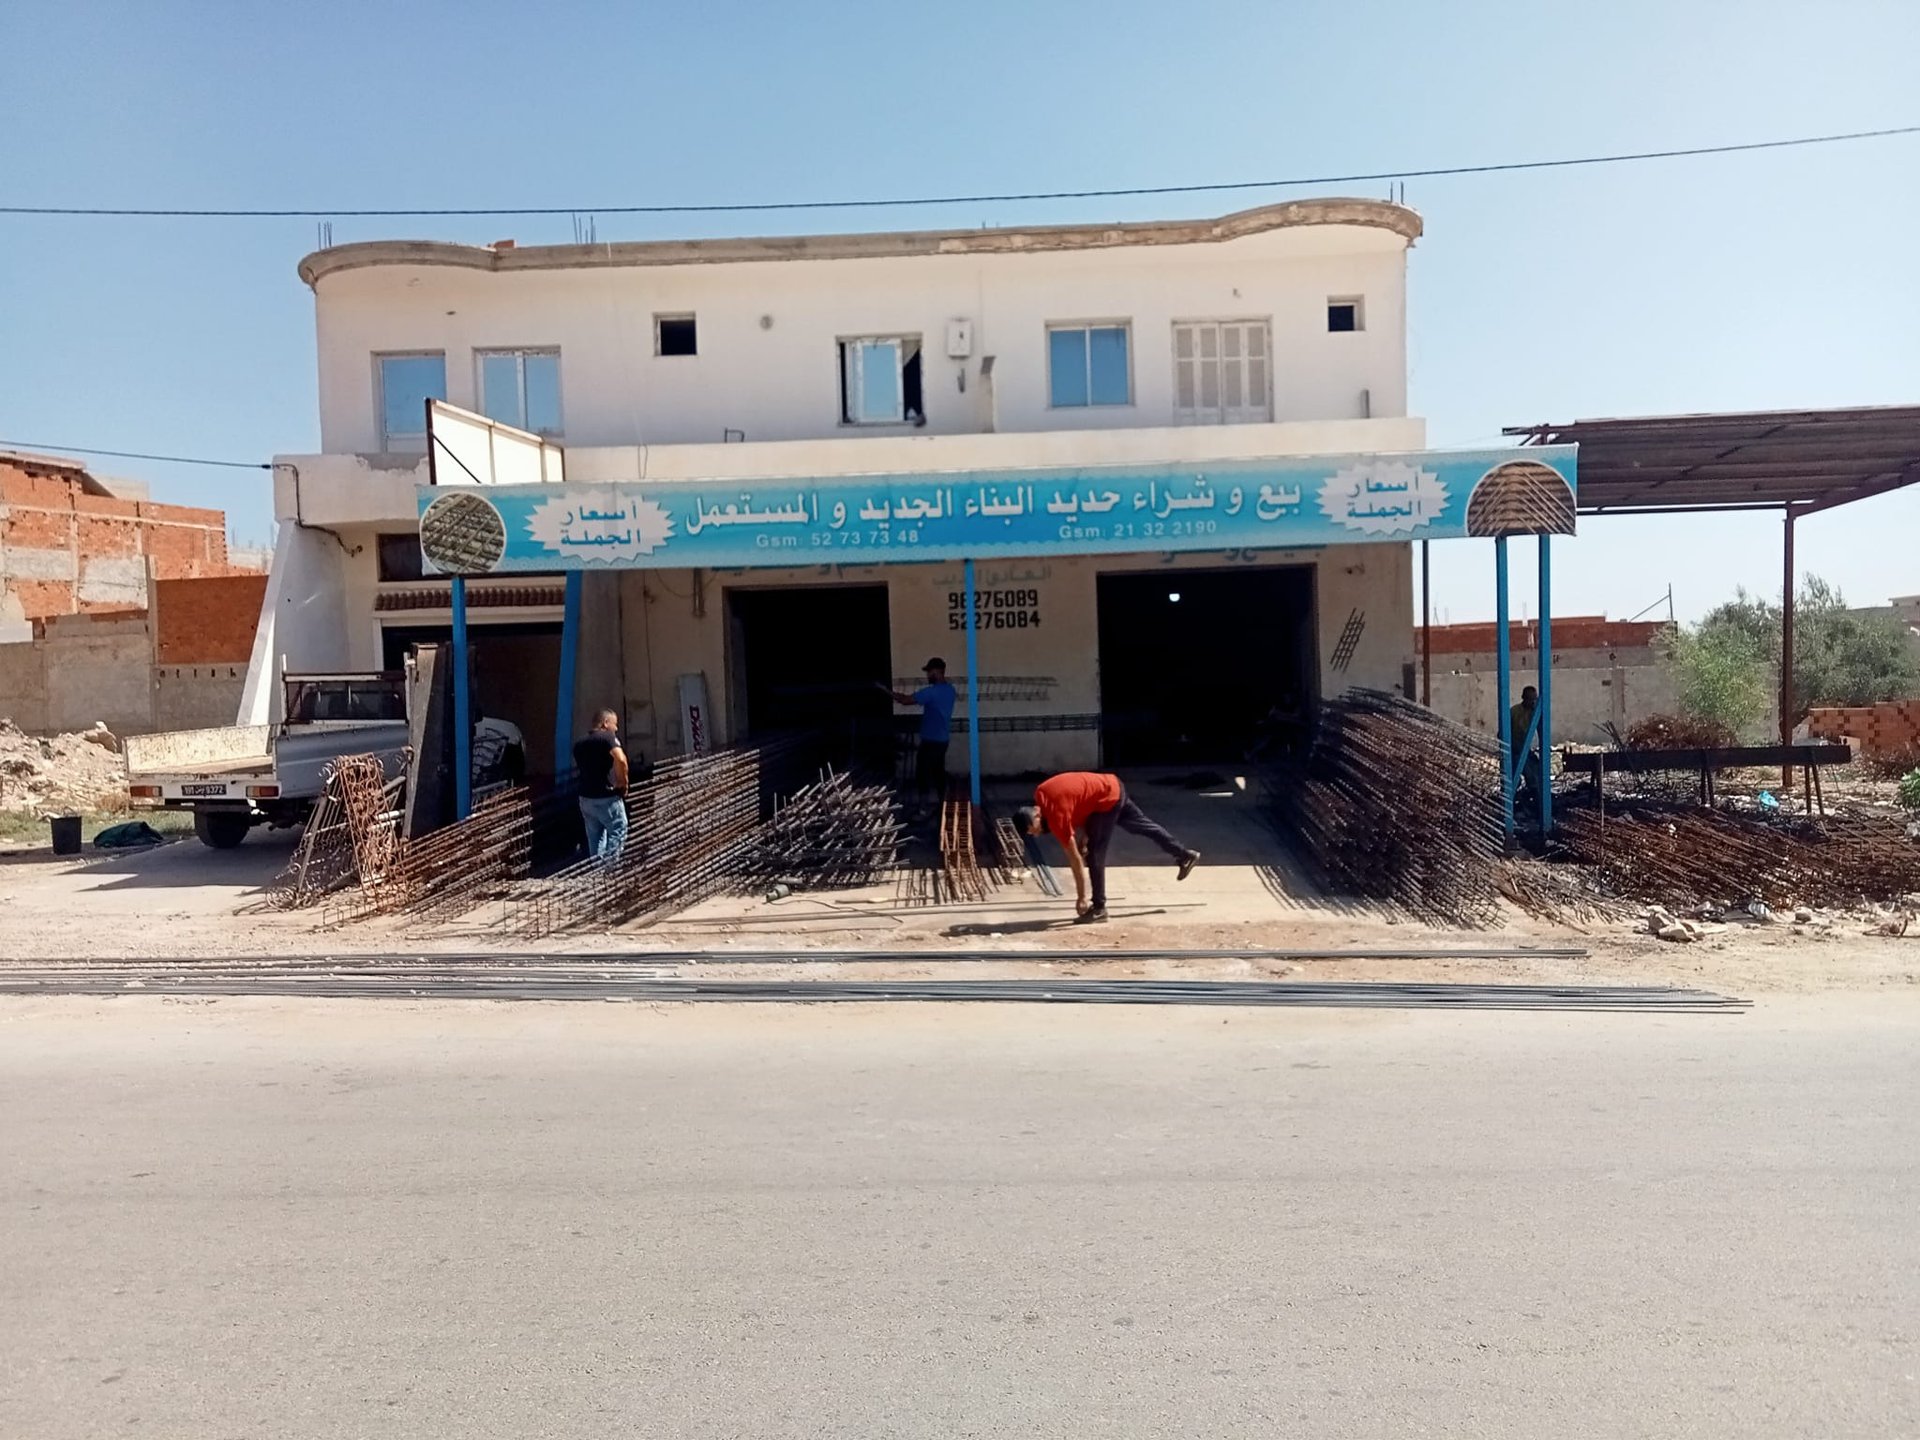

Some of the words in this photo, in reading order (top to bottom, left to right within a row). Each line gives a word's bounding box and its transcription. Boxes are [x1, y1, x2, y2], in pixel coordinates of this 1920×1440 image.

[859, 488, 952, 530] الجديد
[965, 485, 1033, 526] البناء
[1047, 489, 1121, 523] حديد
[1133, 474, 1215, 518] شراء
[1225, 486, 1243, 515] و
[1256, 482, 1301, 521] بيع
[686, 492, 818, 535] المستعمل
[829, 501, 846, 529] و
[1346, 500, 1421, 522] الجملة
[560, 528, 641, 550] الجملة
[811, 532, 832, 545] 52
[840, 532, 861, 545] 73
[869, 531, 890, 544] 73
[897, 530, 919, 543] 48
[1114, 523, 1135, 537] 21
[1143, 522, 1164, 536] 32
[1172, 519, 1217, 535] 2190
[948, 611, 1041, 631] 52276084
